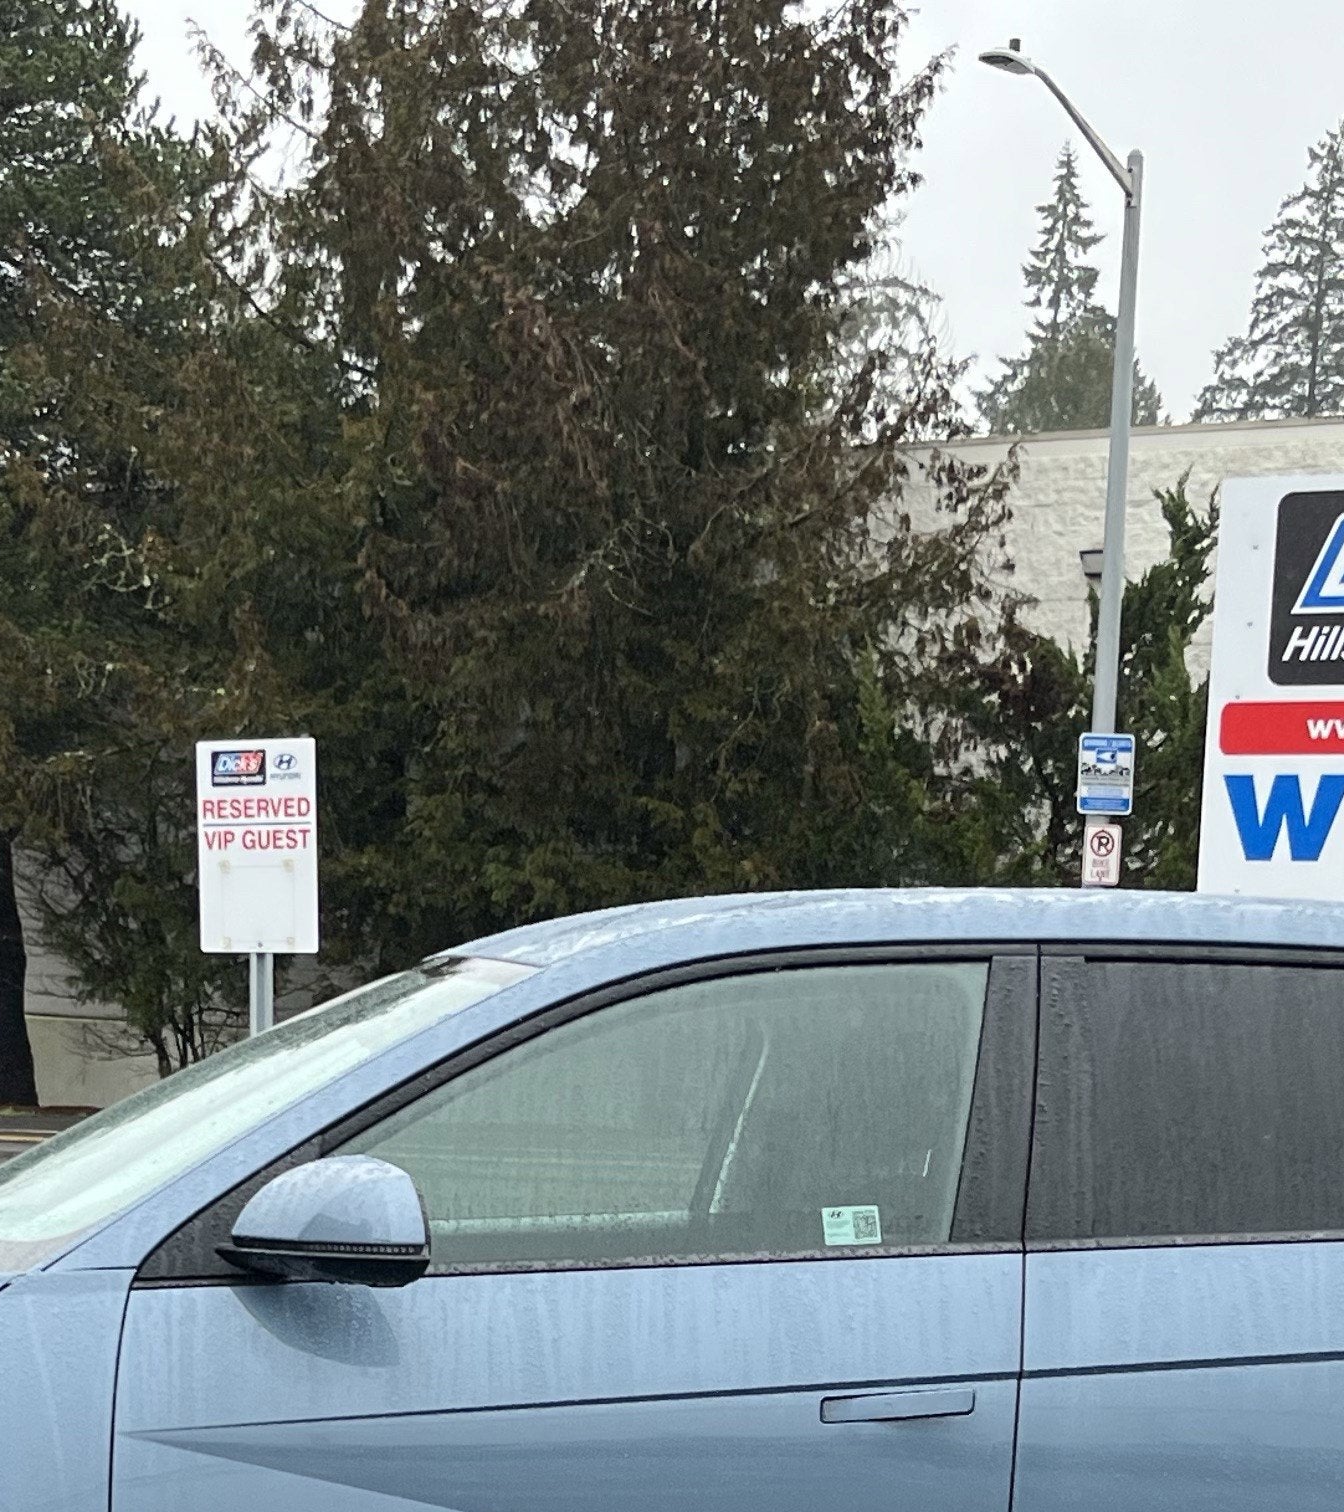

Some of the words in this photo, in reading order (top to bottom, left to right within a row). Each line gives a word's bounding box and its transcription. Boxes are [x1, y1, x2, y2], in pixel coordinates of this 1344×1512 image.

[203, 797, 311, 819] RESERVED
[204, 830, 235, 850] VIP
[242, 829, 311, 850] GUEST
